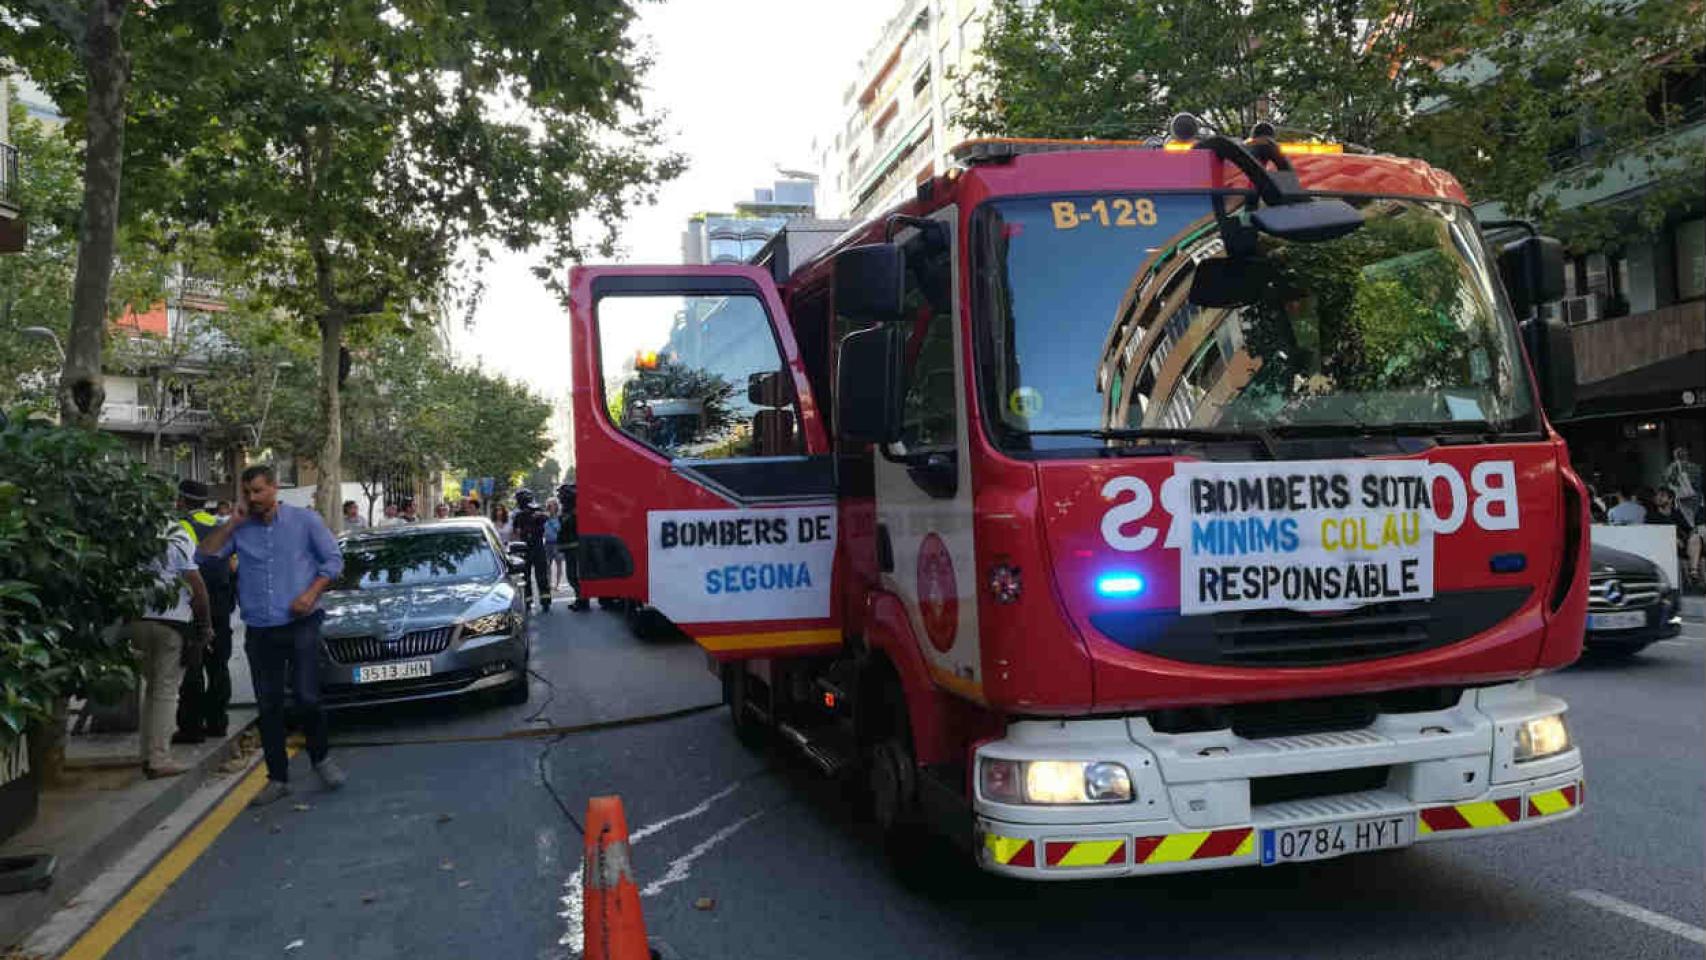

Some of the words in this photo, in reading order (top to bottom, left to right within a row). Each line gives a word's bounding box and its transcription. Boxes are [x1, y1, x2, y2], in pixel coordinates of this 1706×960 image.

[1051, 198, 1157, 229] B-128
[1191, 474, 1350, 514] BOMBERS
[1361, 474, 1431, 509] SOTA
[661, 517, 787, 549] BOMBERS
[797, 515, 831, 544] DE
[1191, 517, 1300, 556] MINIMS
[1321, 512, 1420, 551] COLAU
[706, 561, 812, 594] SEGONA
[1199, 559, 1420, 602] RESPONSABLE
[1280, 825, 1346, 858] 0784
[1356, 818, 1404, 849] HYT
